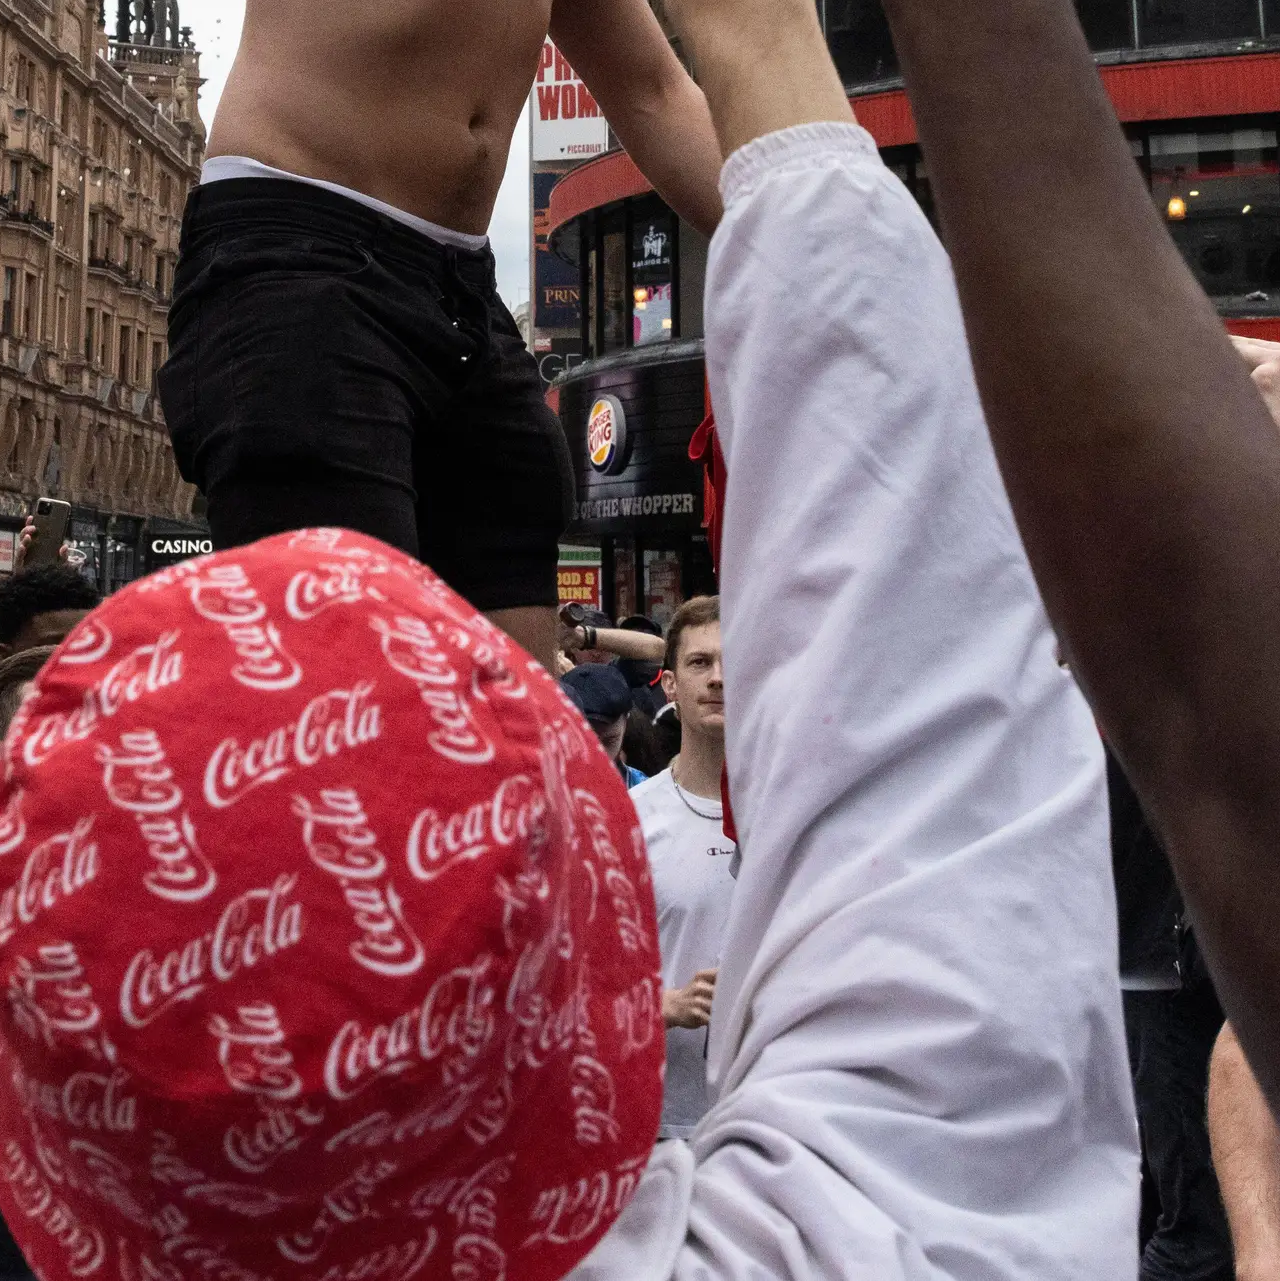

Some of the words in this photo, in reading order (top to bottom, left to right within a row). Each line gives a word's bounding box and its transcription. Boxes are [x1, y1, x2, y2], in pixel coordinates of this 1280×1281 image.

[536, 83, 605, 121] WOM
[588, 409, 611, 434] BURGER
[588, 422, 612, 453] KING
[621, 493, 695, 515] WHOPPER
[151, 539, 214, 554] CASINO
